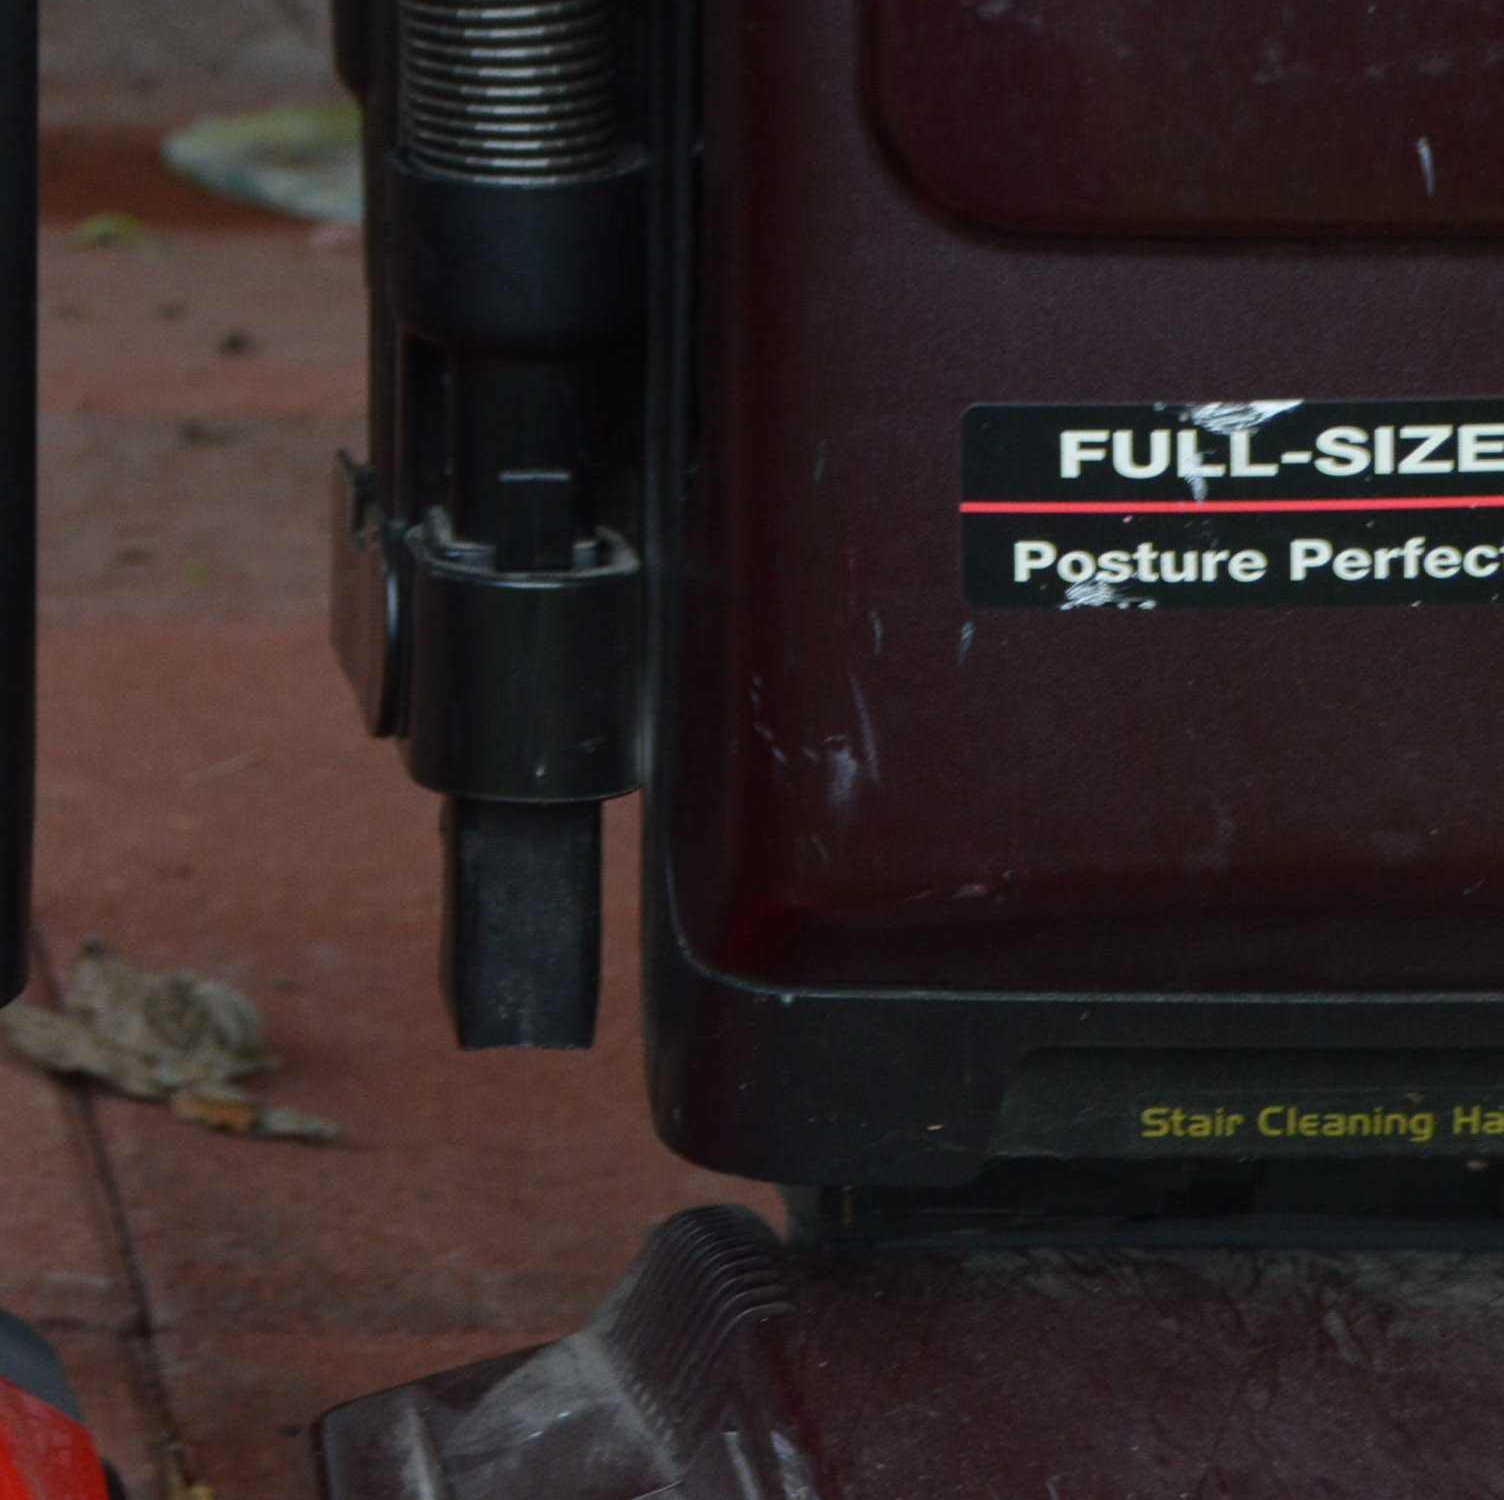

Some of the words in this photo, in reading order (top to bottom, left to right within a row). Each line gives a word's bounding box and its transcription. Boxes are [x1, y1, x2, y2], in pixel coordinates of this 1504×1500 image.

[1059, 423, 1504, 479] FULL-SIZE
[1013, 540, 1268, 584] Posture
[1289, 536, 1504, 583] Perfec
[1140, 1106, 1244, 1138] Stair
[1256, 1104, 1435, 1143] Cleaning
[1451, 1104, 1504, 1136] Ha
